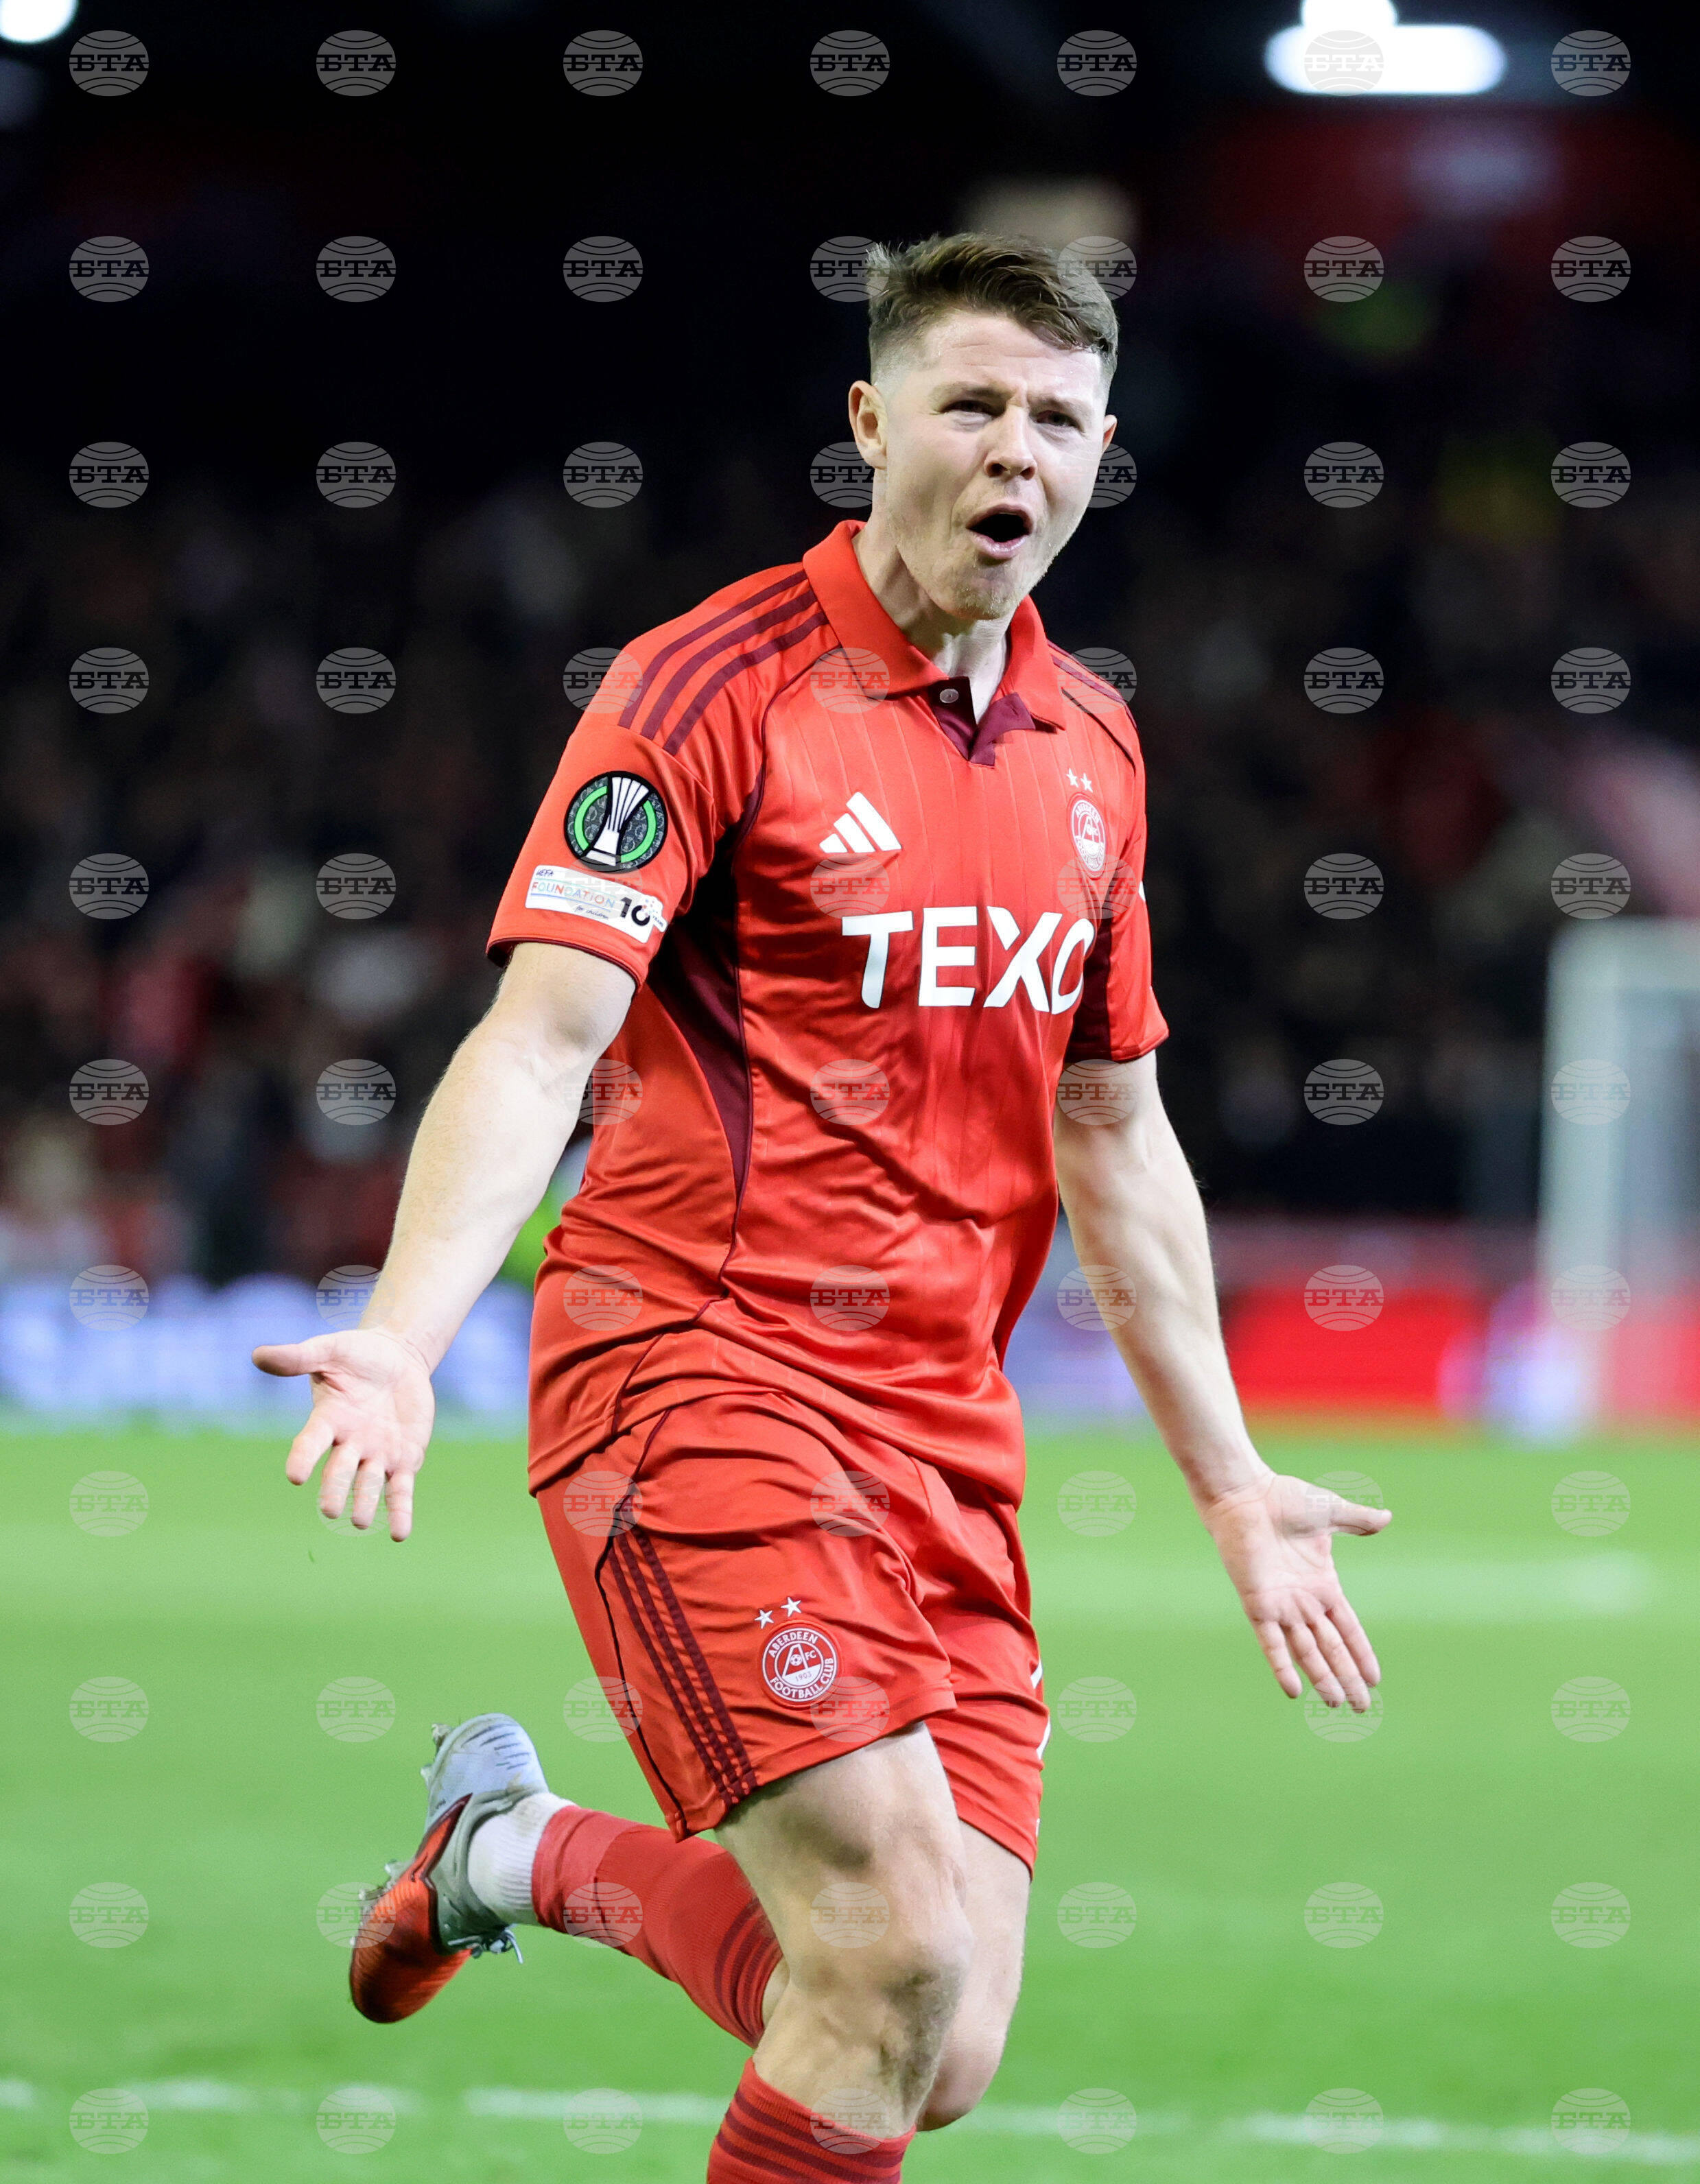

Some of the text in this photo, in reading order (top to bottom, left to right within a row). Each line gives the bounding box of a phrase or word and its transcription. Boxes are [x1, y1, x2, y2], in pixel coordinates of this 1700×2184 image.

[532, 881, 615, 908] FOUNDATION
[842, 905, 1094, 1015] TEXO
[768, 1631, 818, 1658] ABERDEEN
[770, 1657, 834, 1699] FOOTBALL CLUB
[795, 1671, 812, 1682] 1903
